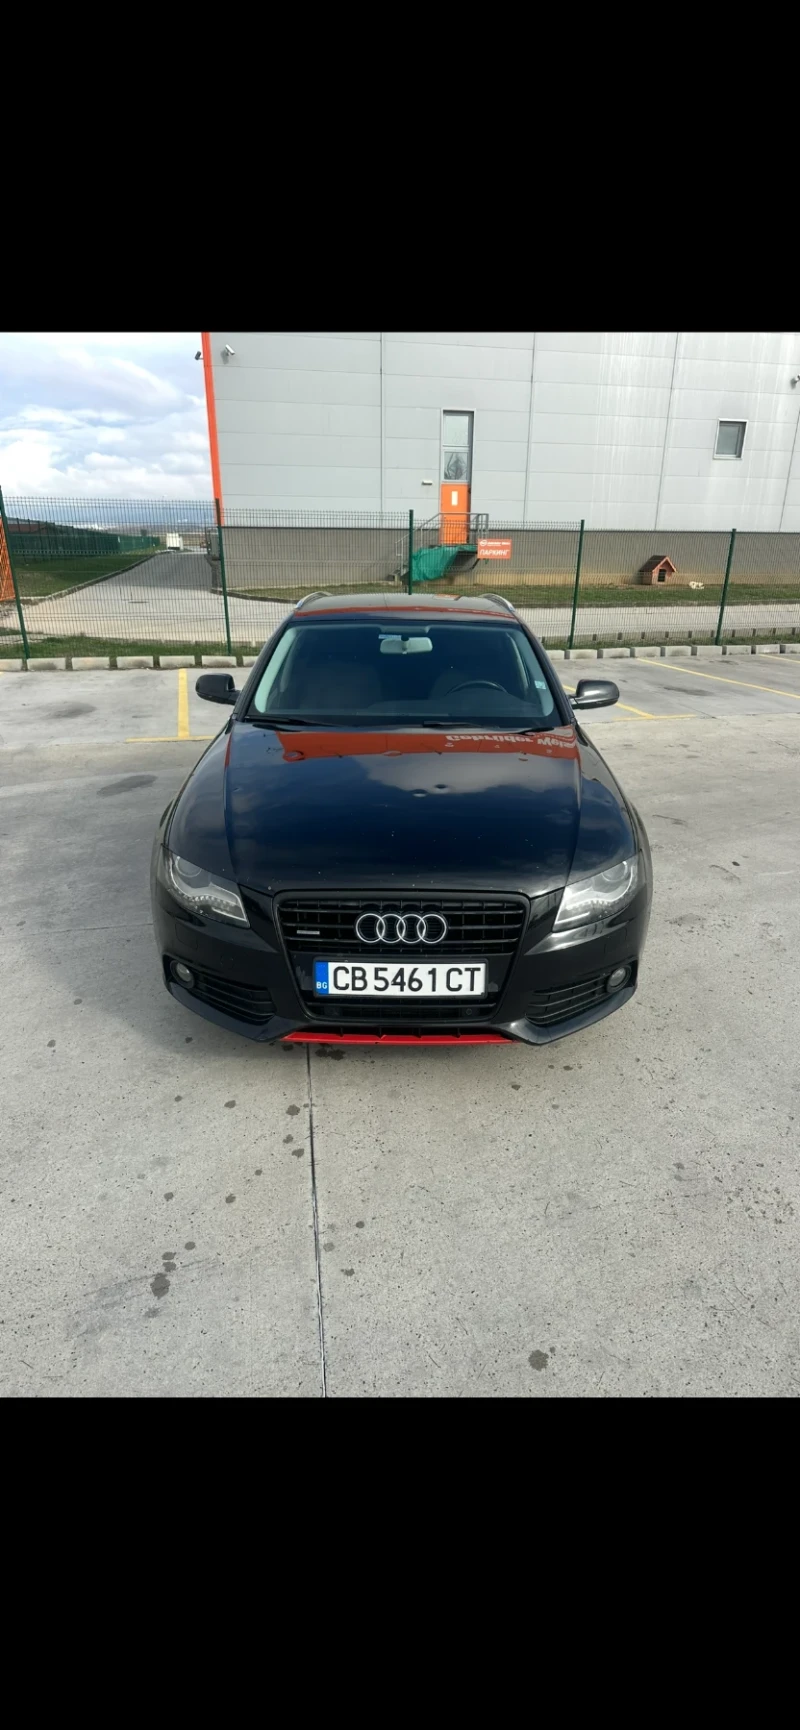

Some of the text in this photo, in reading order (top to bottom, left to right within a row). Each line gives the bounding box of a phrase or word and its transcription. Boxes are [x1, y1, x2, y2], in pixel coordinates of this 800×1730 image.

[316, 981, 328, 990] BG
[333, 966, 481, 992] CB 5461 CT
